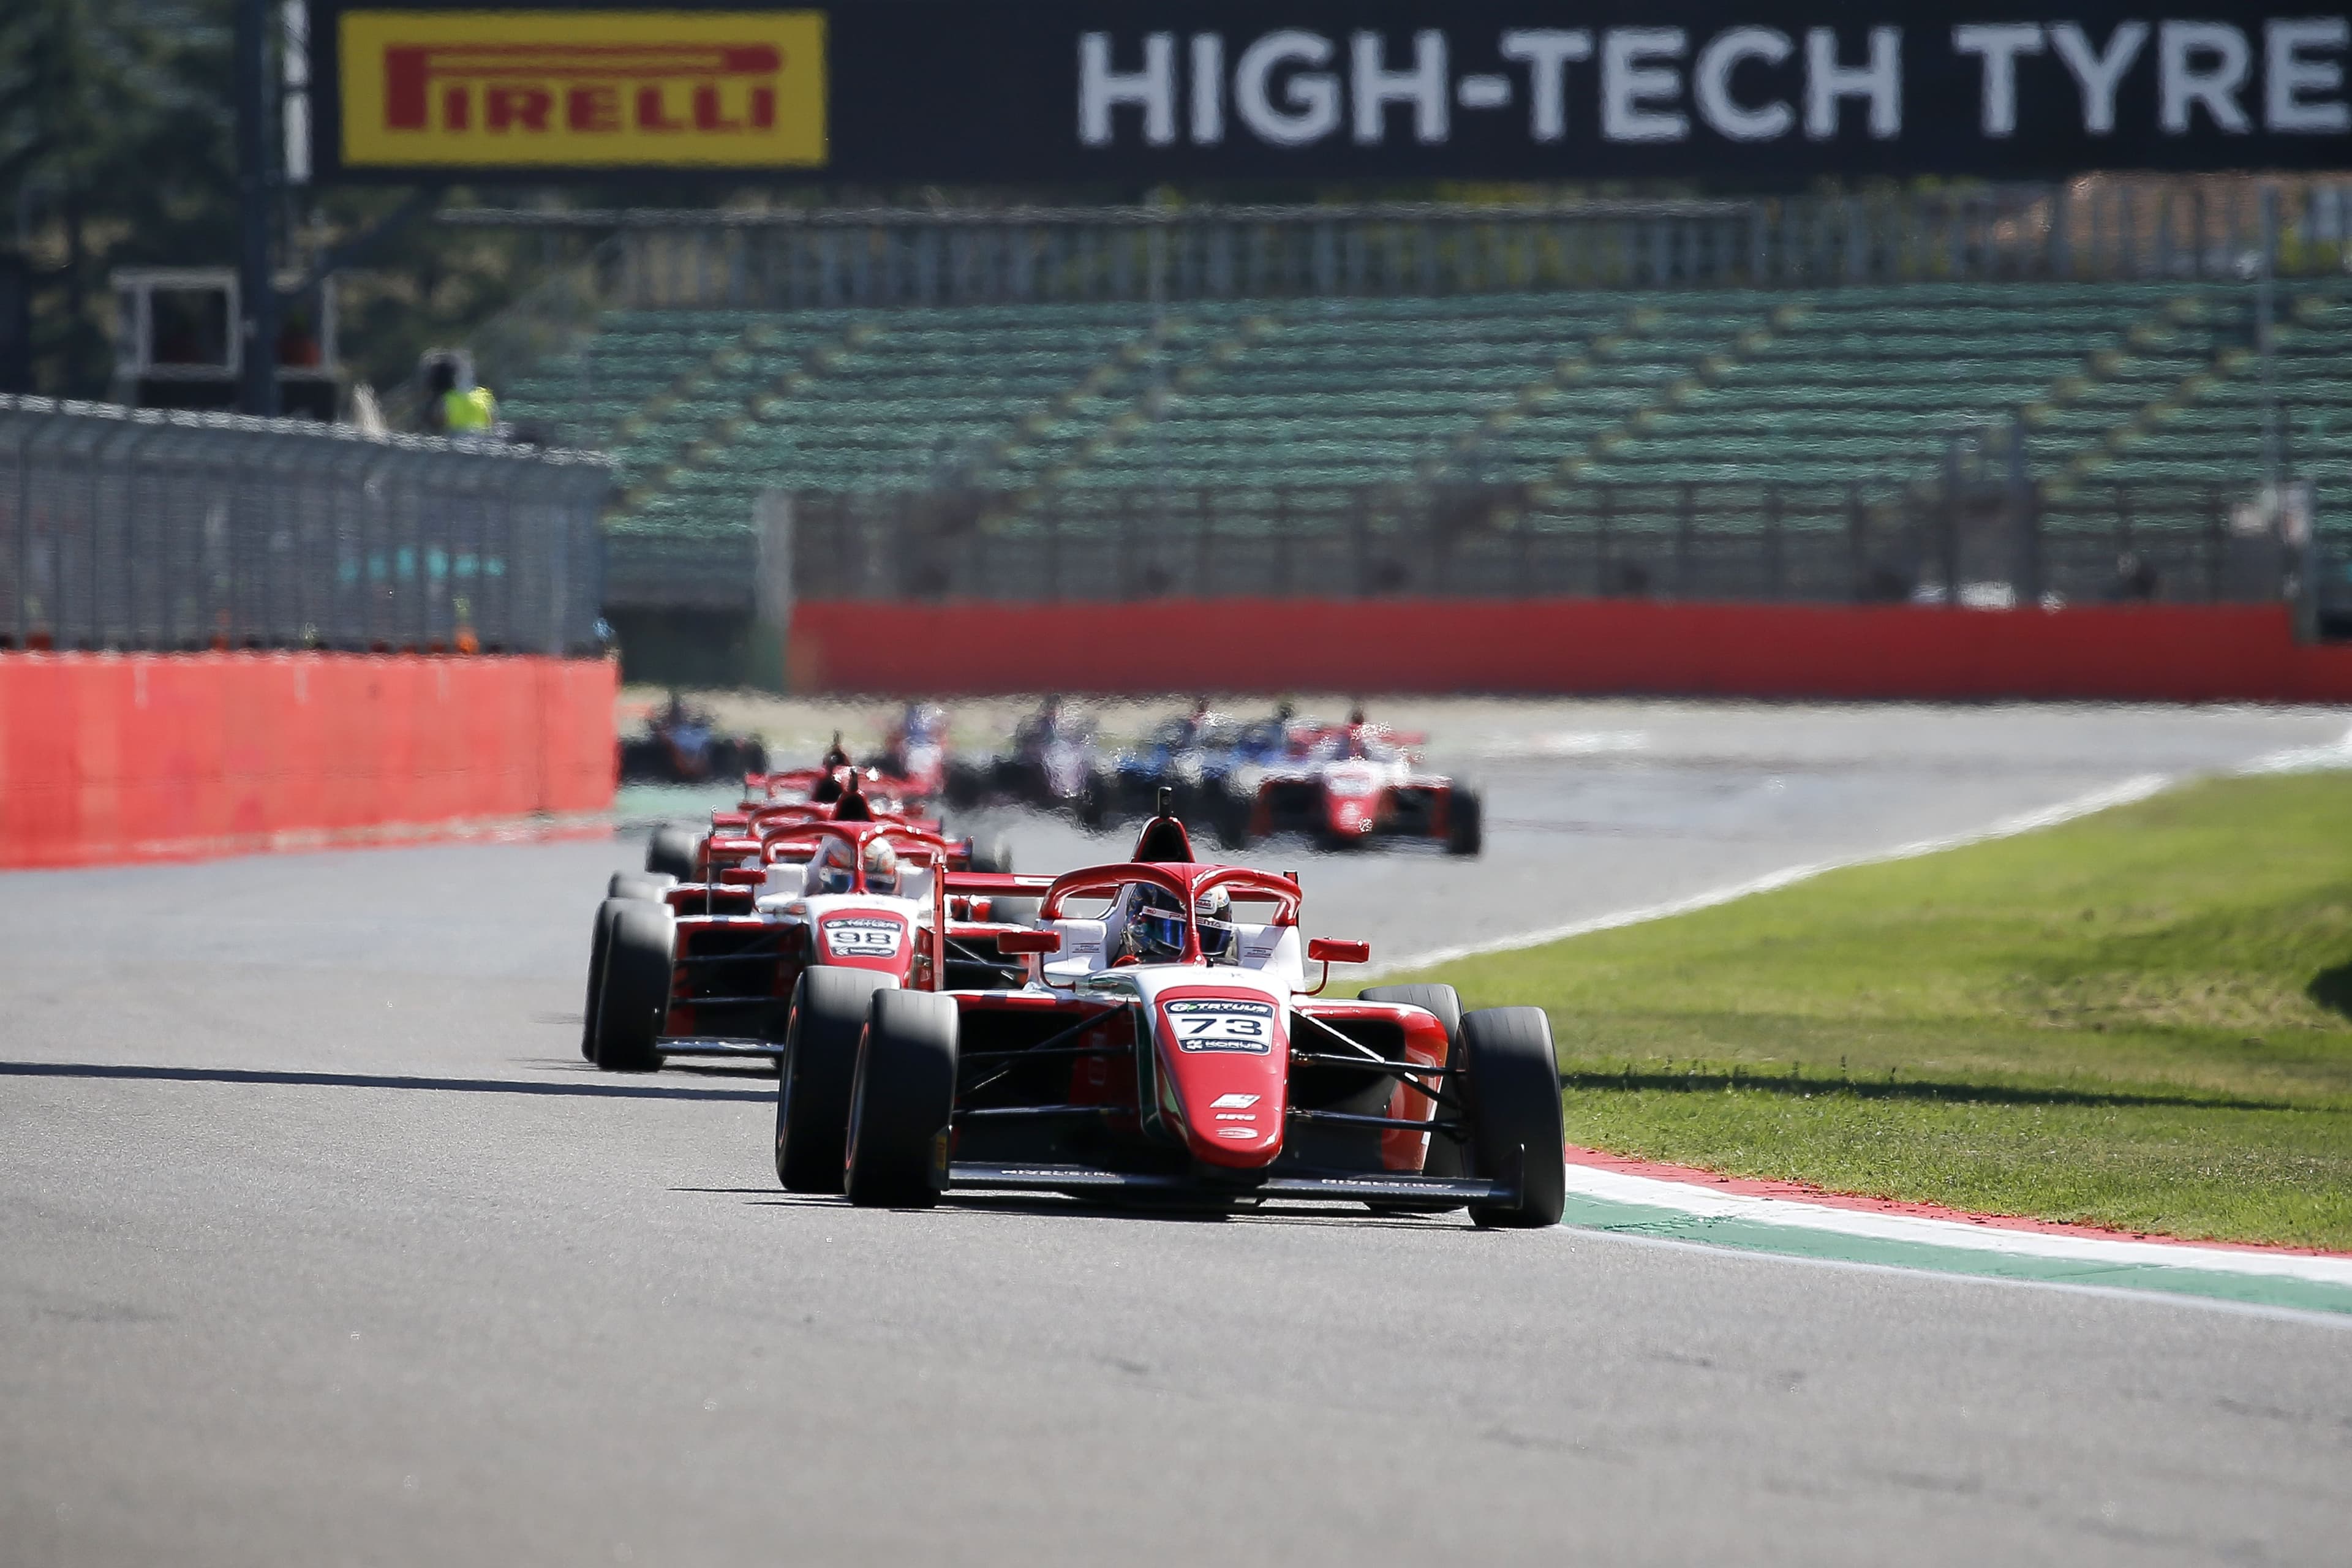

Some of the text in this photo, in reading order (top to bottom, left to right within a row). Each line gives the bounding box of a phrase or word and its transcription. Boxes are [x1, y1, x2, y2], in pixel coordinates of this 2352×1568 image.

[385, 43, 783, 132] PIRELLI
[1078, 18, 2351, 145] HIGH-TECH TYRE
[834, 932, 891, 944] 98
[1197, 1003, 1268, 1012] TATUUS
[1181, 1018, 1262, 1035] 73
